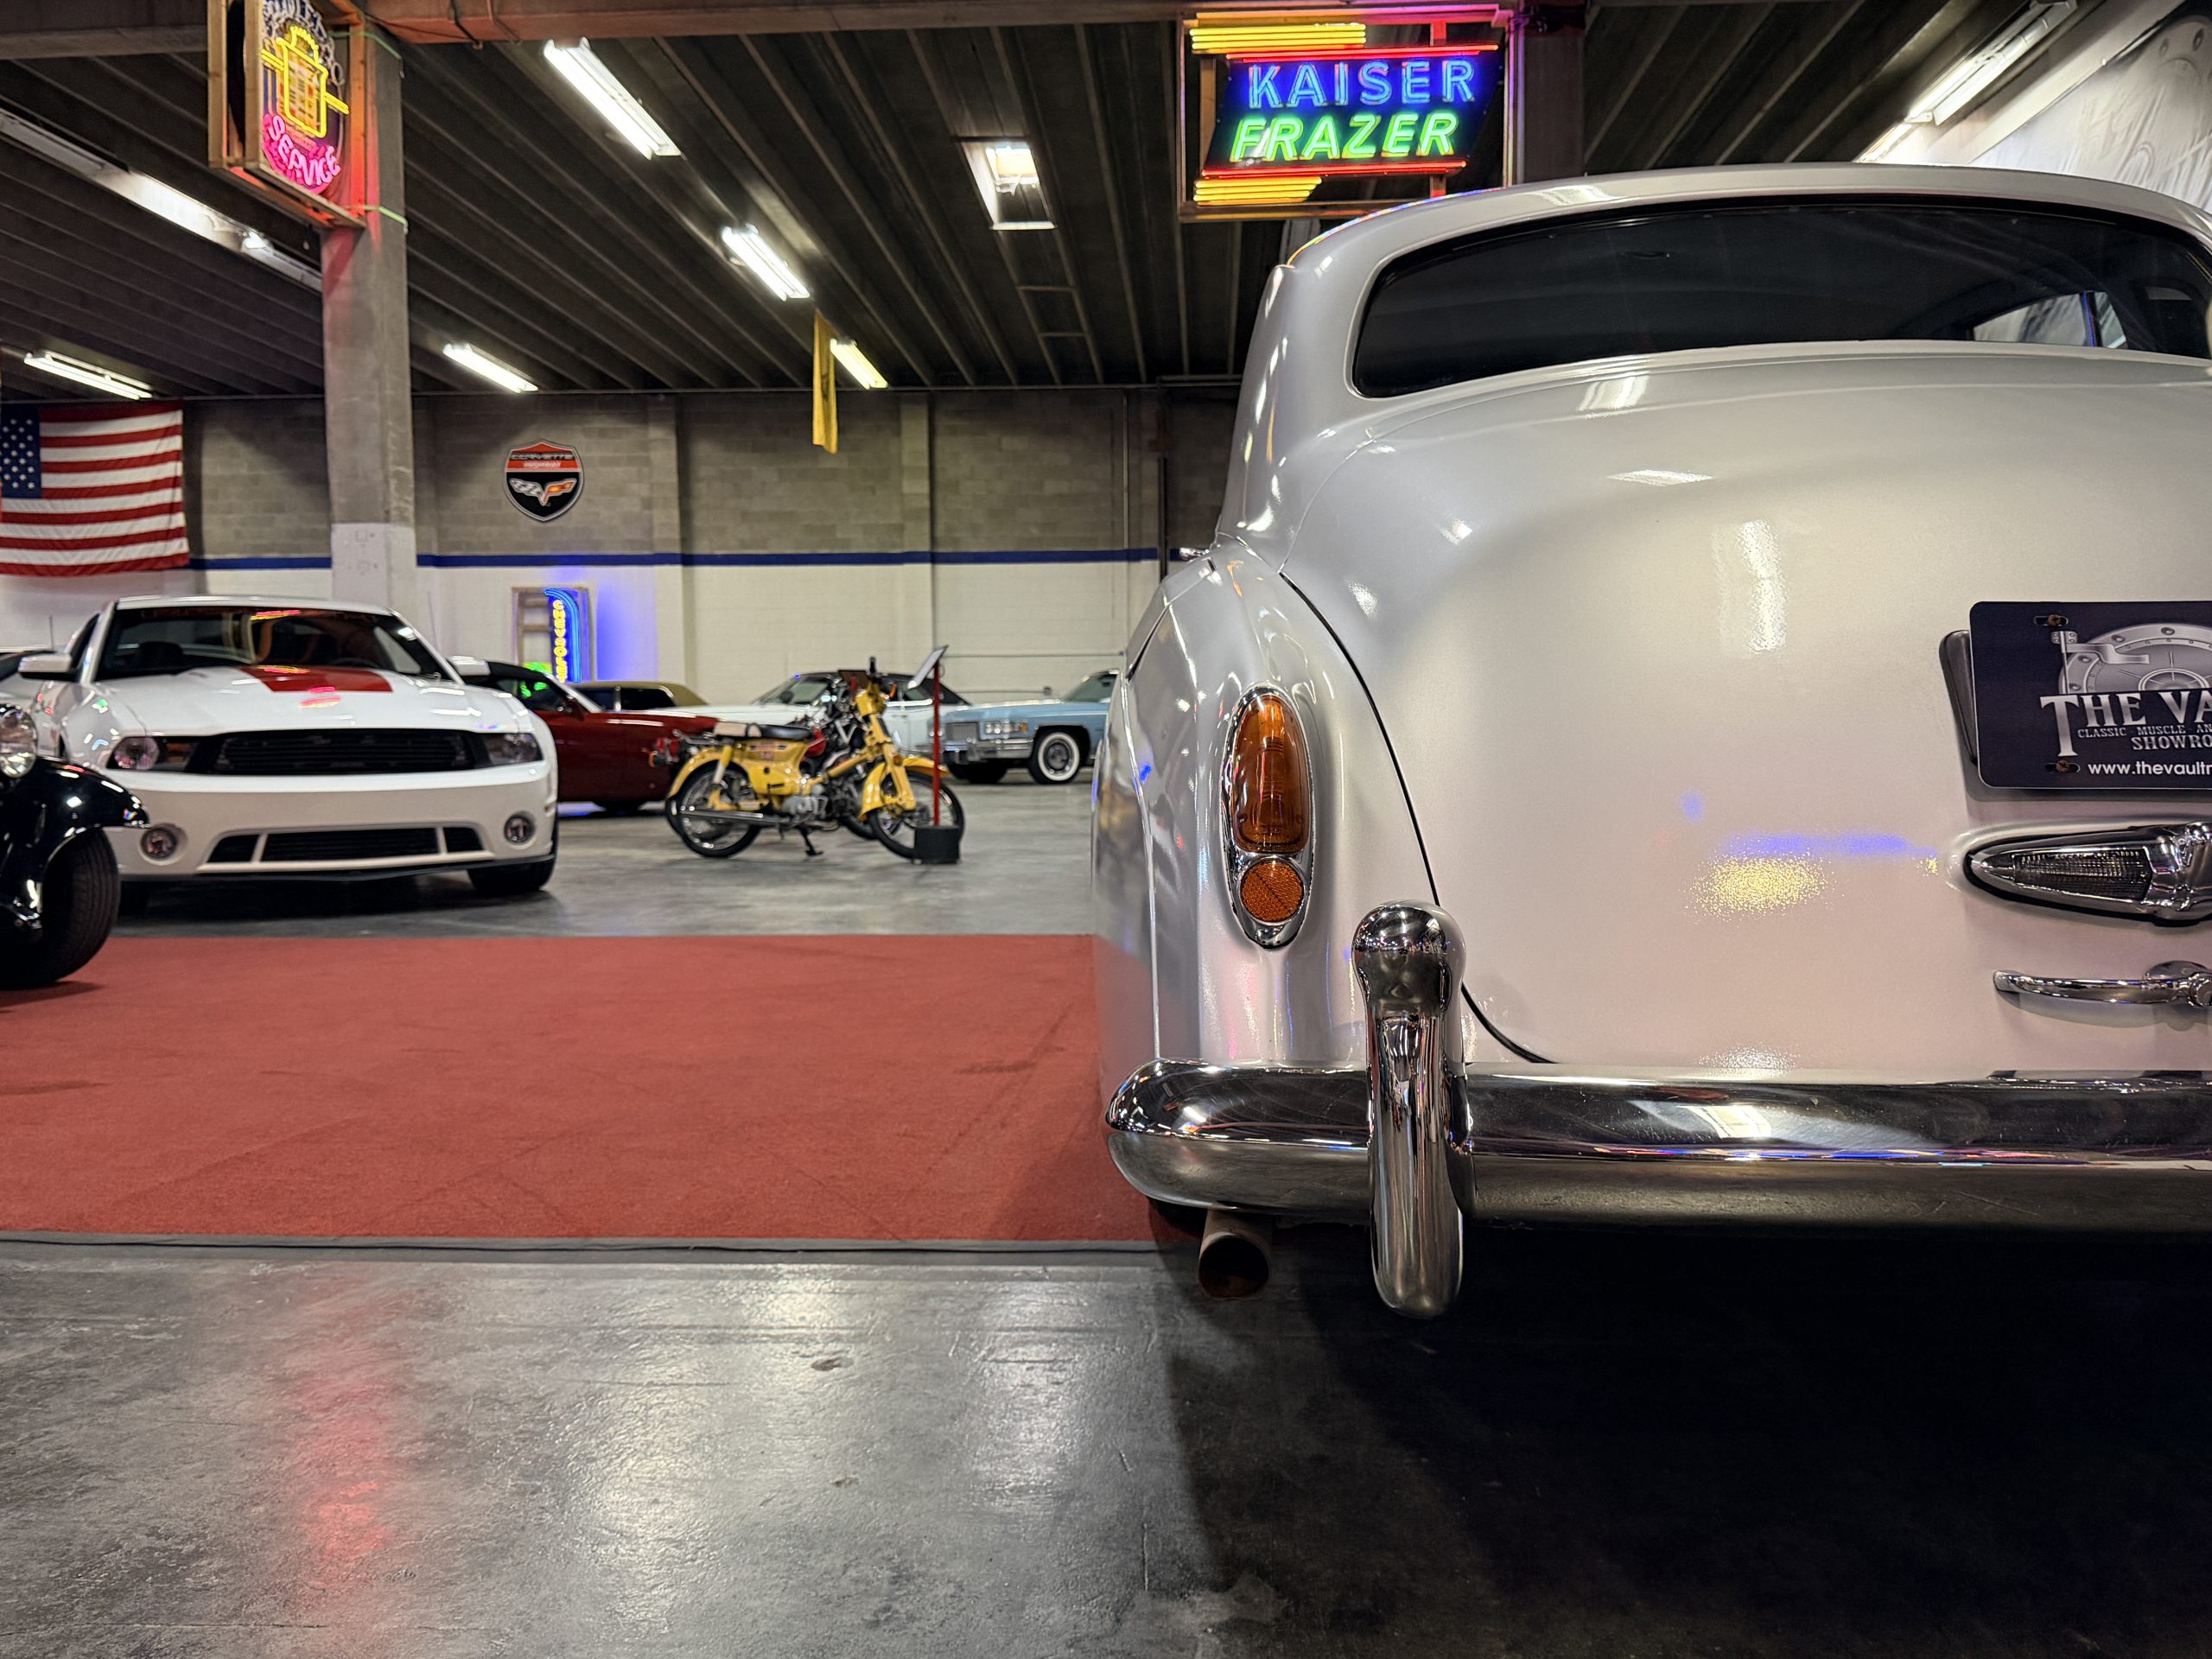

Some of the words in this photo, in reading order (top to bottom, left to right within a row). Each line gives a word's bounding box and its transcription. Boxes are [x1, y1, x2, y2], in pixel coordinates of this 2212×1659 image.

[1249, 60, 1475, 109] KAISER
[267, 115, 340, 186] SERVICE
[1229, 111, 1459, 162] FRAZER
[2040, 692, 2146, 757] THE
[2158, 690, 2212, 723] VA
[2077, 727, 2127, 738] CLASSIC
[2136, 724, 2186, 736] MUSCLE
[2131, 734, 2212, 750] SHOWRO
